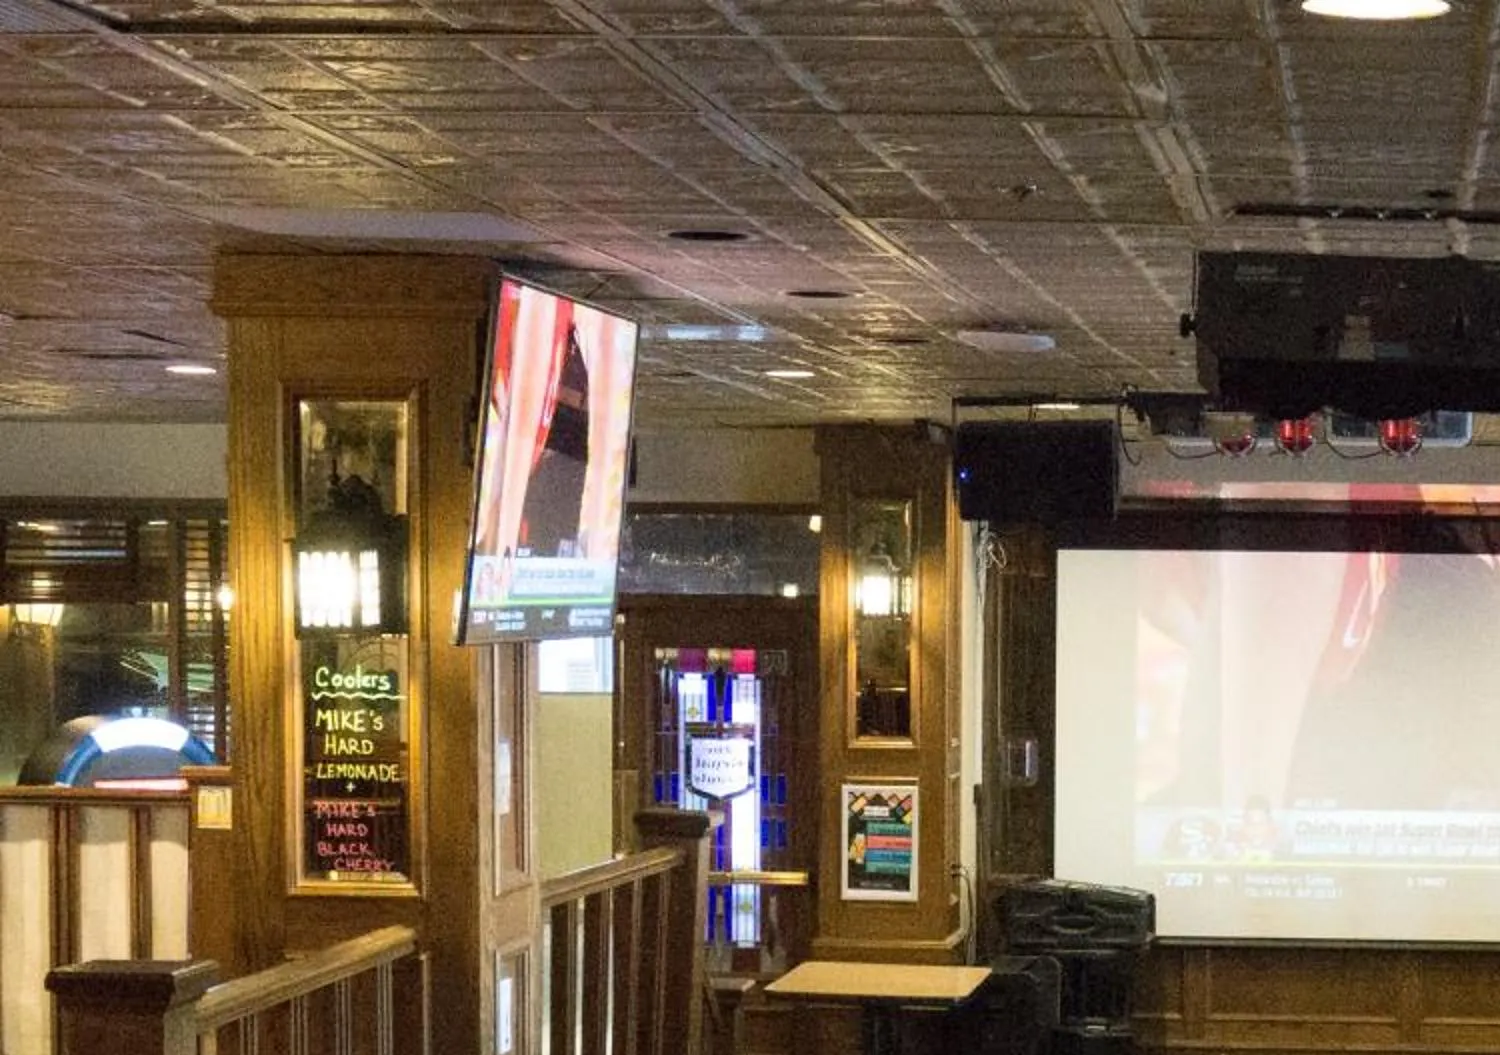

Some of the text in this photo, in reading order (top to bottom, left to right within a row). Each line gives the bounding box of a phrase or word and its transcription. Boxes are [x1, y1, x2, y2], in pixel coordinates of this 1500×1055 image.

[315, 664, 391, 690] Coolers
[315, 709, 384, 733] MIKE's
[324, 734, 374, 756] HARD
[316, 763, 401, 782] LEMONADE
[326, 823, 369, 837] HARD
